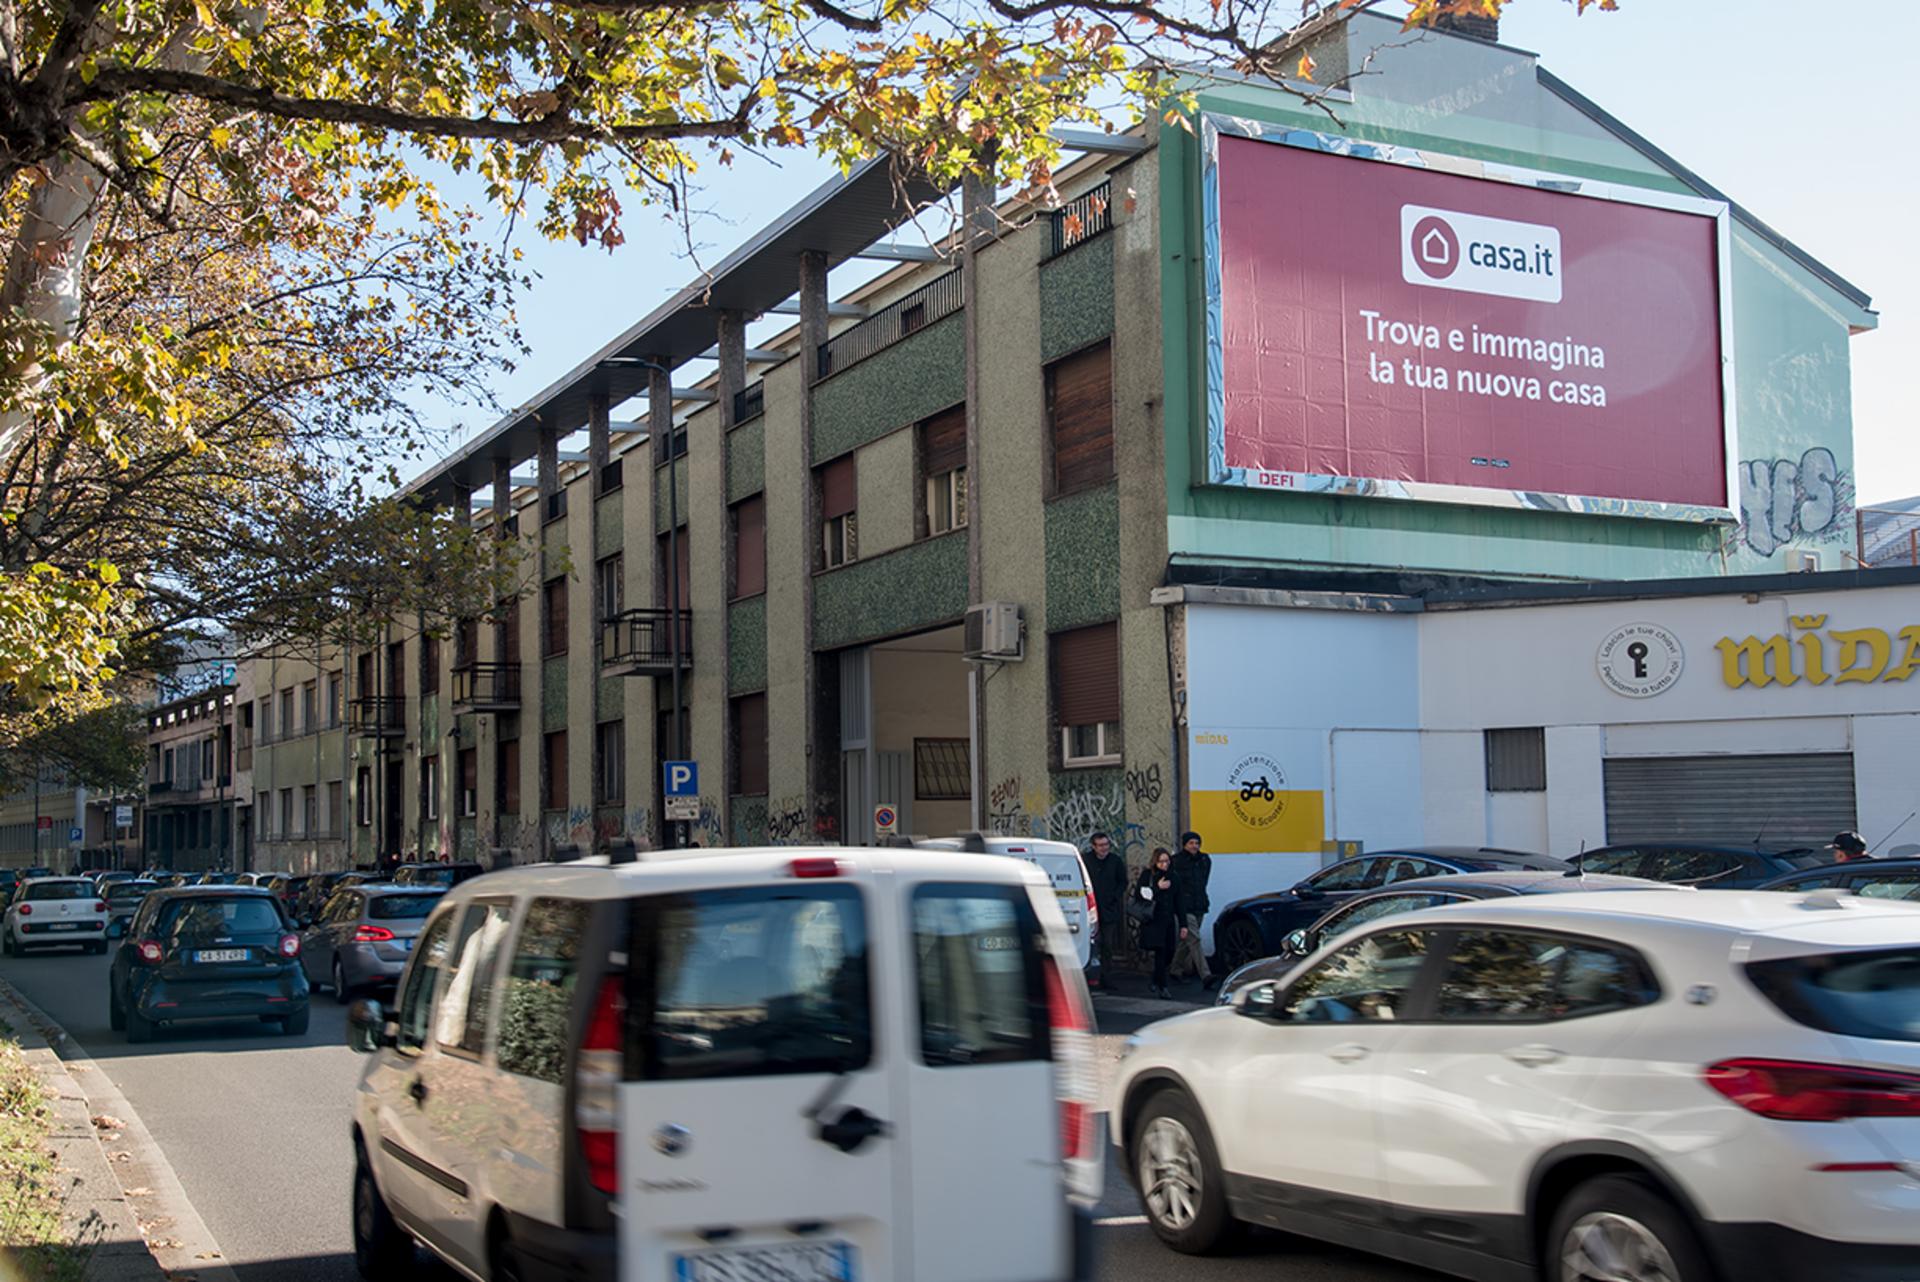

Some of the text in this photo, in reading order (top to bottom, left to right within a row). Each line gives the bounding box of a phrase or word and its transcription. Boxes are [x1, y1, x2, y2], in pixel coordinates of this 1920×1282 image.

[1469, 242, 1553, 276] casa.it
[1359, 309, 1605, 371] Trova e immagina
[1369, 351, 1607, 407] la tua nuova casa
[1259, 473, 1294, 487] DEFI
[1601, 632, 1625, 657] Lascia
[1637, 626, 1654, 635] tue
[1655, 631, 1677, 653] chiavi
[1650, 675, 1672, 692] tutto
[672, 766, 691, 792] P
[1228, 756, 1285, 785] Manutenzione
[1231, 799, 1249, 822] Moto
[1258, 800, 1285, 826] Scooter
[71, 829, 80, 839] P
